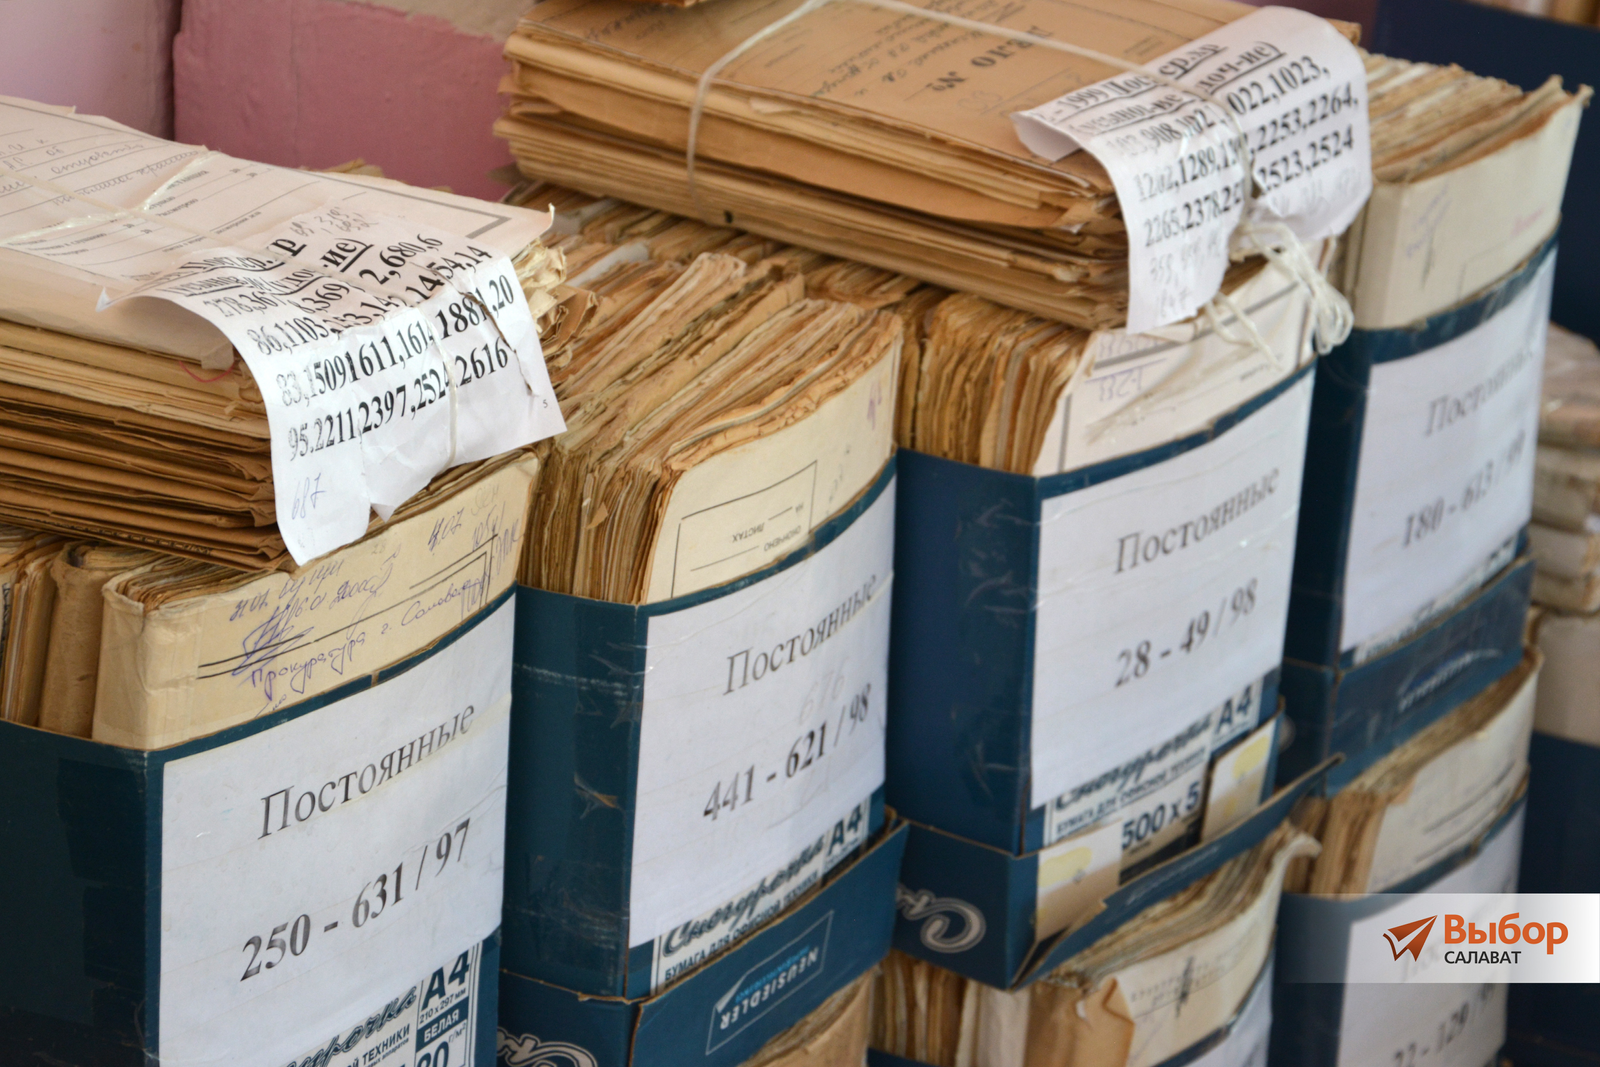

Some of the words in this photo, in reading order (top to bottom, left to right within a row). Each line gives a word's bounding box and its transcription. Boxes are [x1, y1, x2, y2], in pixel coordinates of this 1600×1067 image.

[1113, 468, 1280, 576] Постоянные
[722, 574, 877, 696] Постоянные
[1115, 640, 1152, 689] 28
[1180, 610, 1211, 654] 49
[1229, 577, 1259, 626] 98
[257, 705, 475, 840] Постоянные
[703, 764, 756, 821] 441
[785, 721, 828, 780] 621
[849, 682, 872, 724] 98
[1122, 803, 1166, 850] 500
[1185, 779, 1201, 812] 5
[240, 913, 311, 982] 250
[352, 861, 404, 928] 631
[415, 845, 428, 891] /
[434, 818, 471, 878] 97
[664, 947, 706, 981] БУМАГА
[708, 932, 732, 955] ДЛЯ
[719, 946, 819, 1032] NEUSIEDLER
[362, 1022, 411, 1066] ТЕХНИКИ
[420, 1008, 434, 1025] 210
[440, 994, 455, 1012] 297
[423, 1008, 461, 1044] БЕЛАЯ
